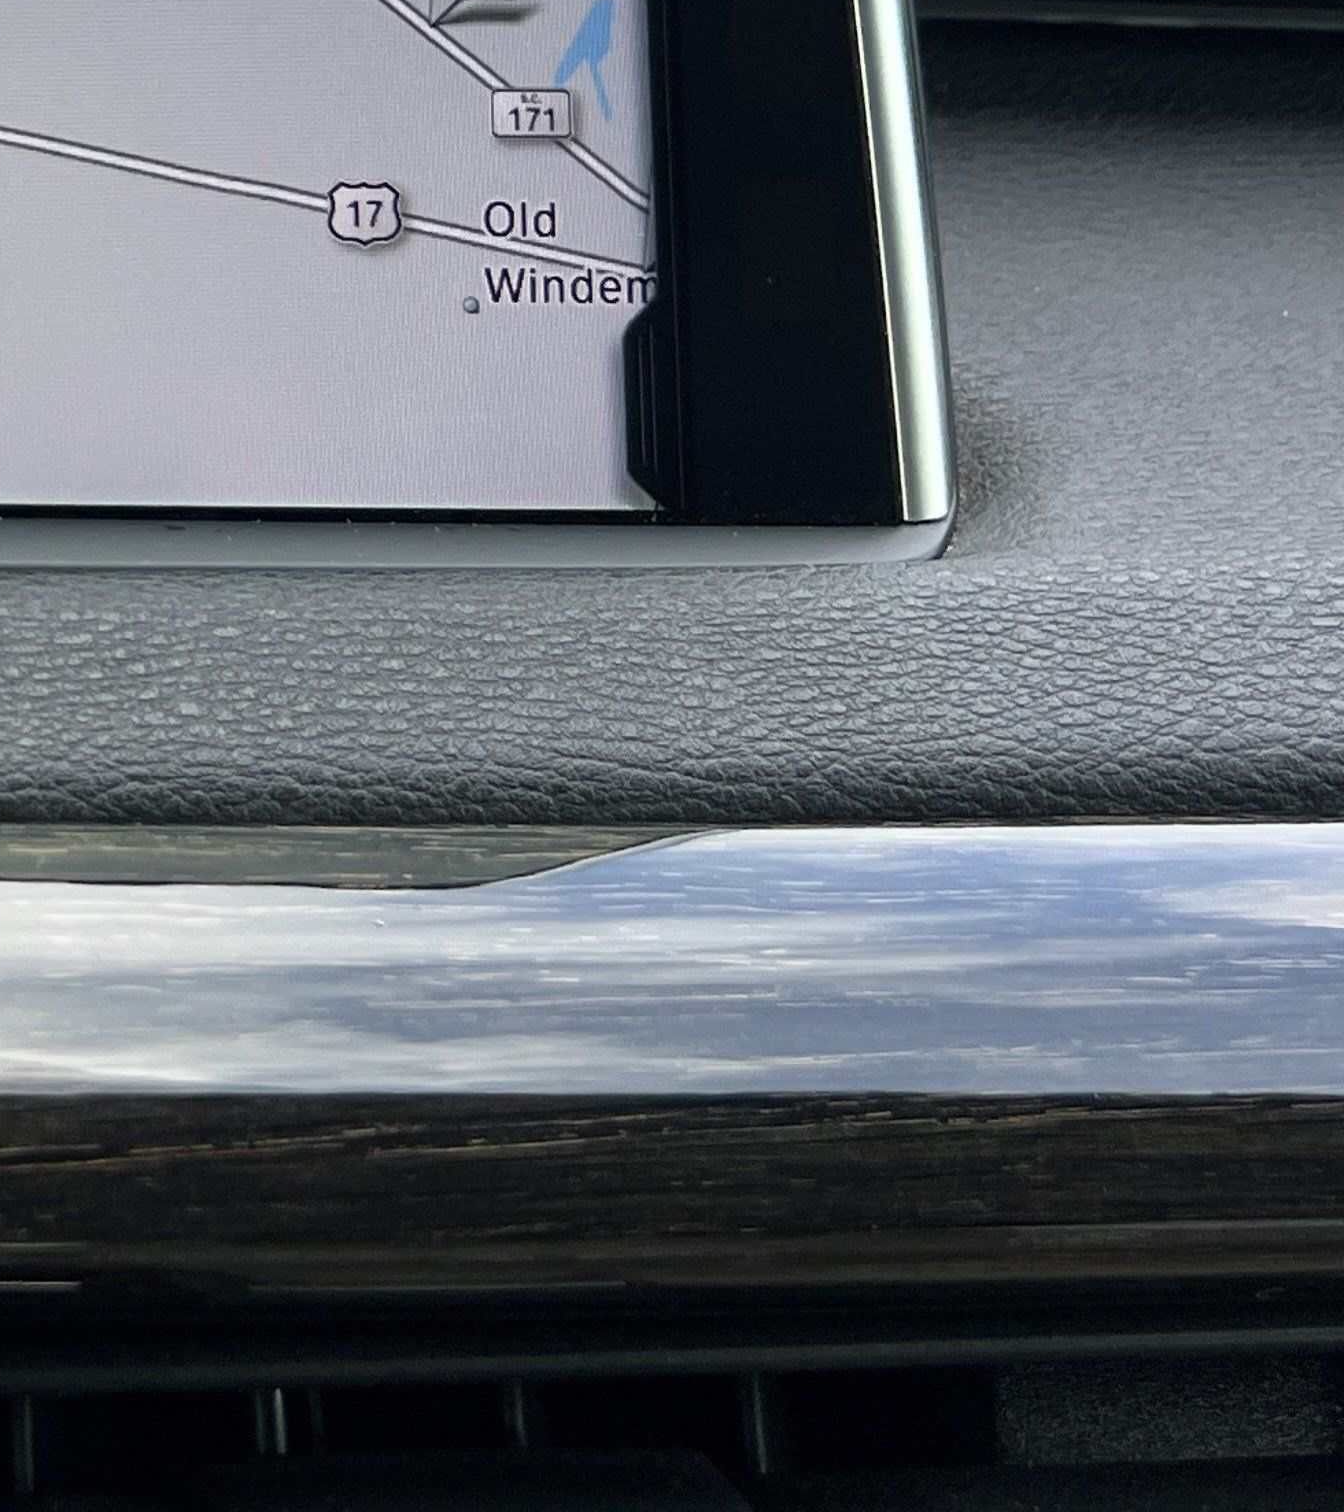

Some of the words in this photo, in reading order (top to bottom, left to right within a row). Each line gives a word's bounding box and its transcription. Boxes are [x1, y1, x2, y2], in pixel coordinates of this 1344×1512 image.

[508, 106, 555, 132] 171
[346, 199, 384, 228] 17
[482, 200, 557, 239] Old
